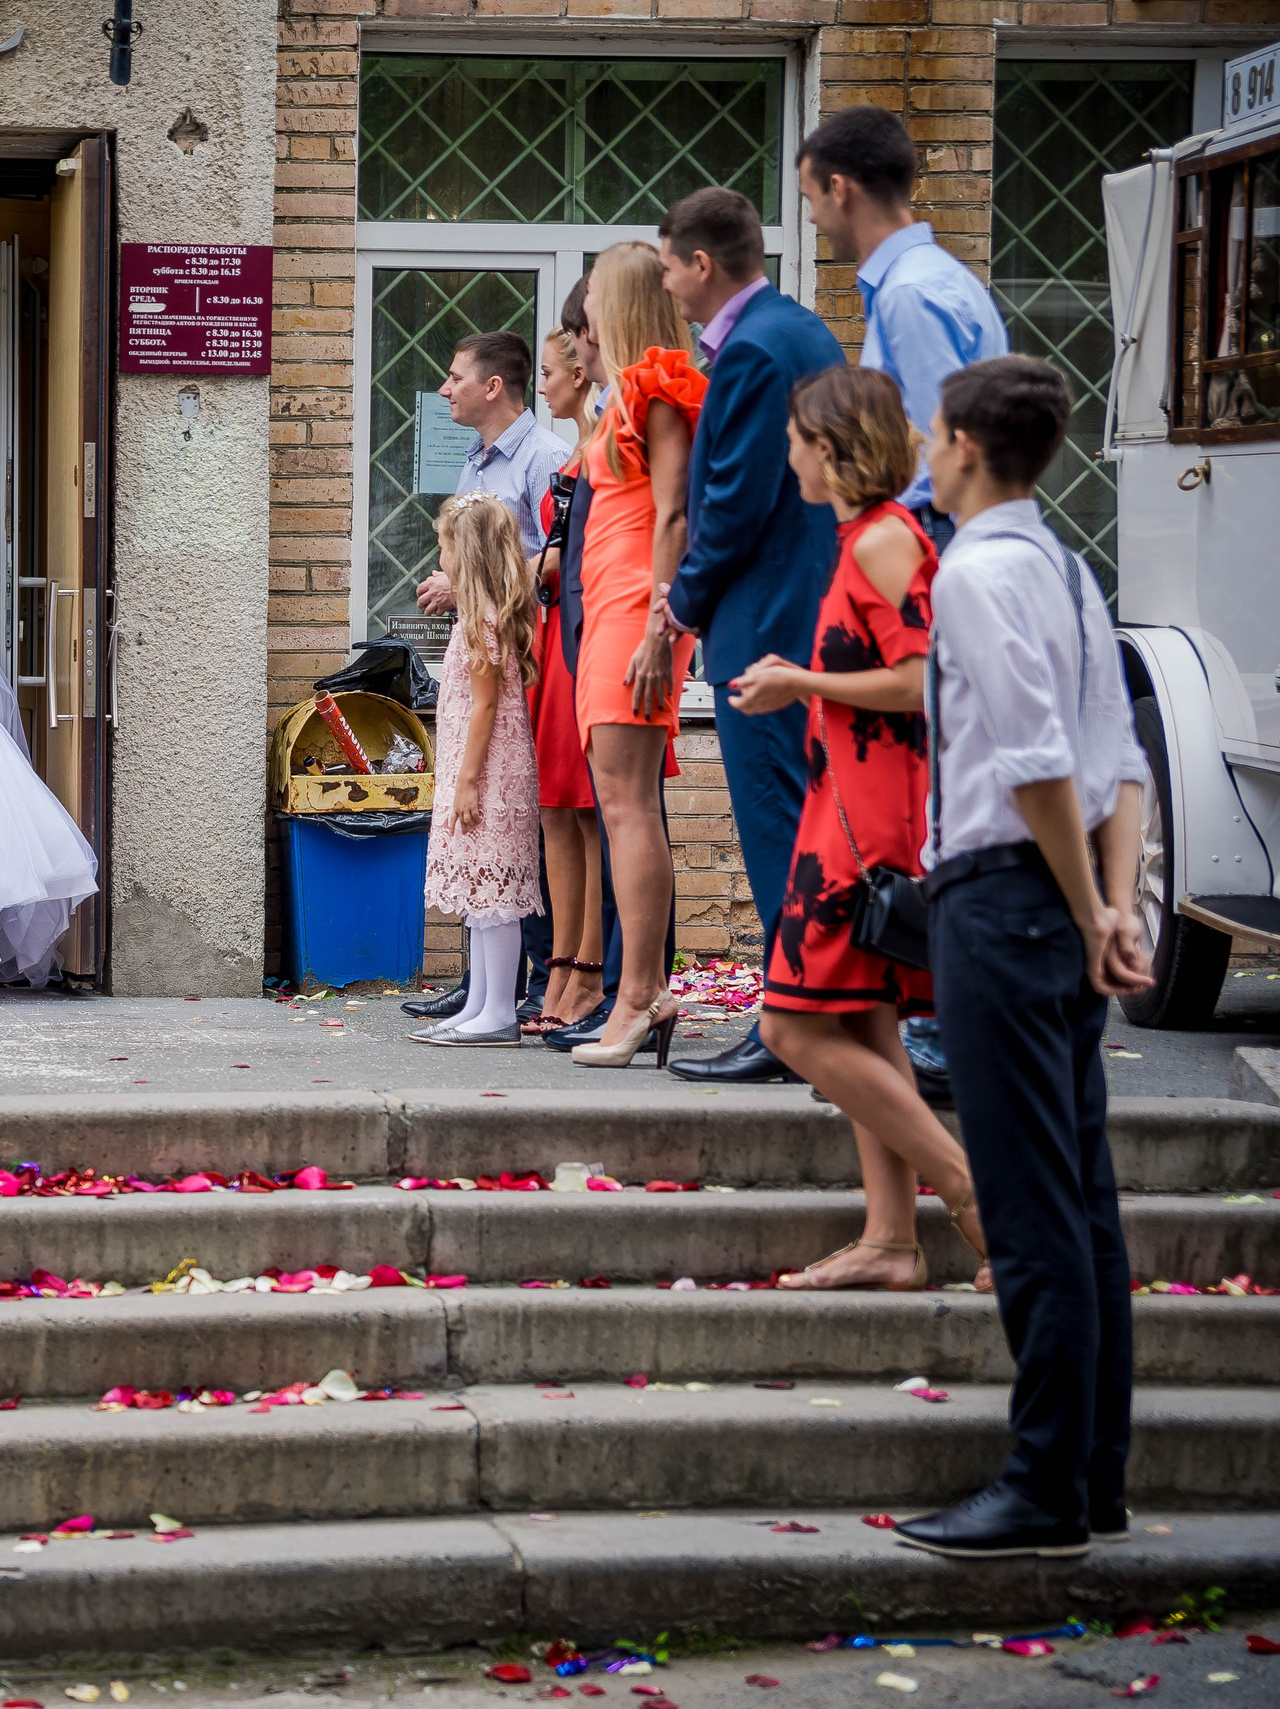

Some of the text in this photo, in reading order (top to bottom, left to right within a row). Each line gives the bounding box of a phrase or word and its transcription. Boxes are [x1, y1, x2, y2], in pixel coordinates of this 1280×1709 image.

[1232, 59, 1275, 115] 8 914
[148, 246, 208, 254] РАСПОРЯДОК
[153, 267, 184, 276] суббота
[243, 297, 263, 305] 16.30
[129, 328, 171, 336] ПЯТНИЦА
[392, 621, 449, 631] Извините, вход
